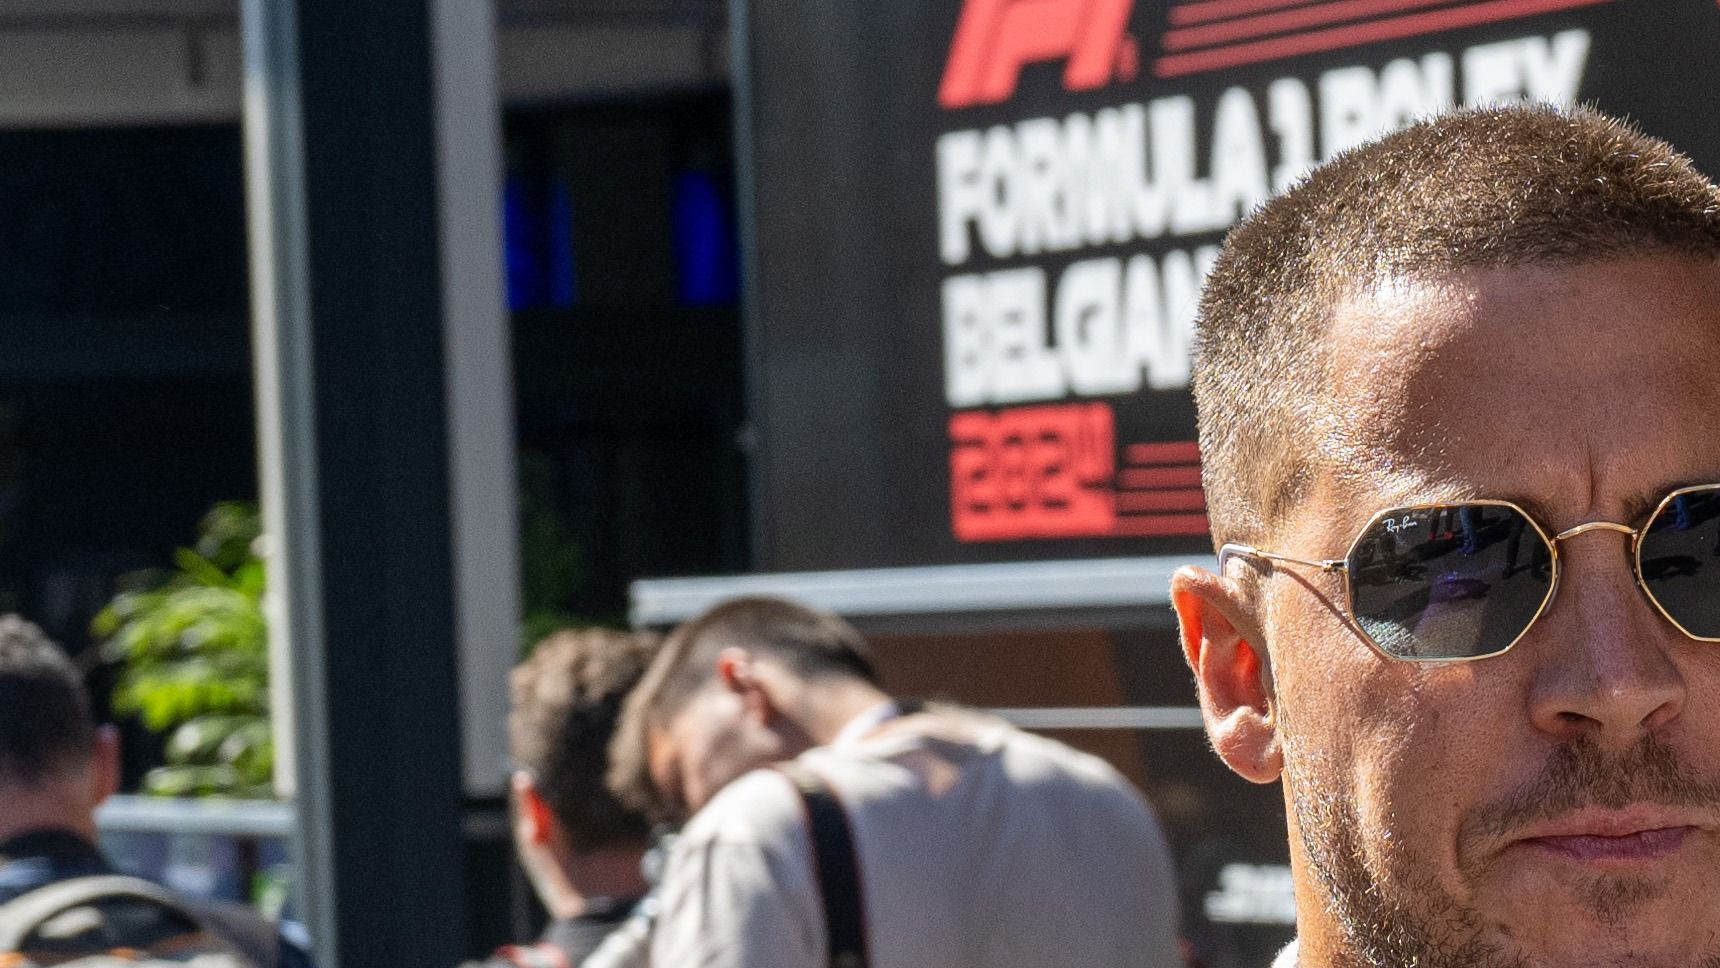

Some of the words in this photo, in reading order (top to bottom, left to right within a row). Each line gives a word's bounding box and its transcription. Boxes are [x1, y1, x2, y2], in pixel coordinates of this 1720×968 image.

[936, 85, 1270, 262] FORMULA
[1269, 77, 1320, 188] 1
[949, 402, 1116, 542] 2024
